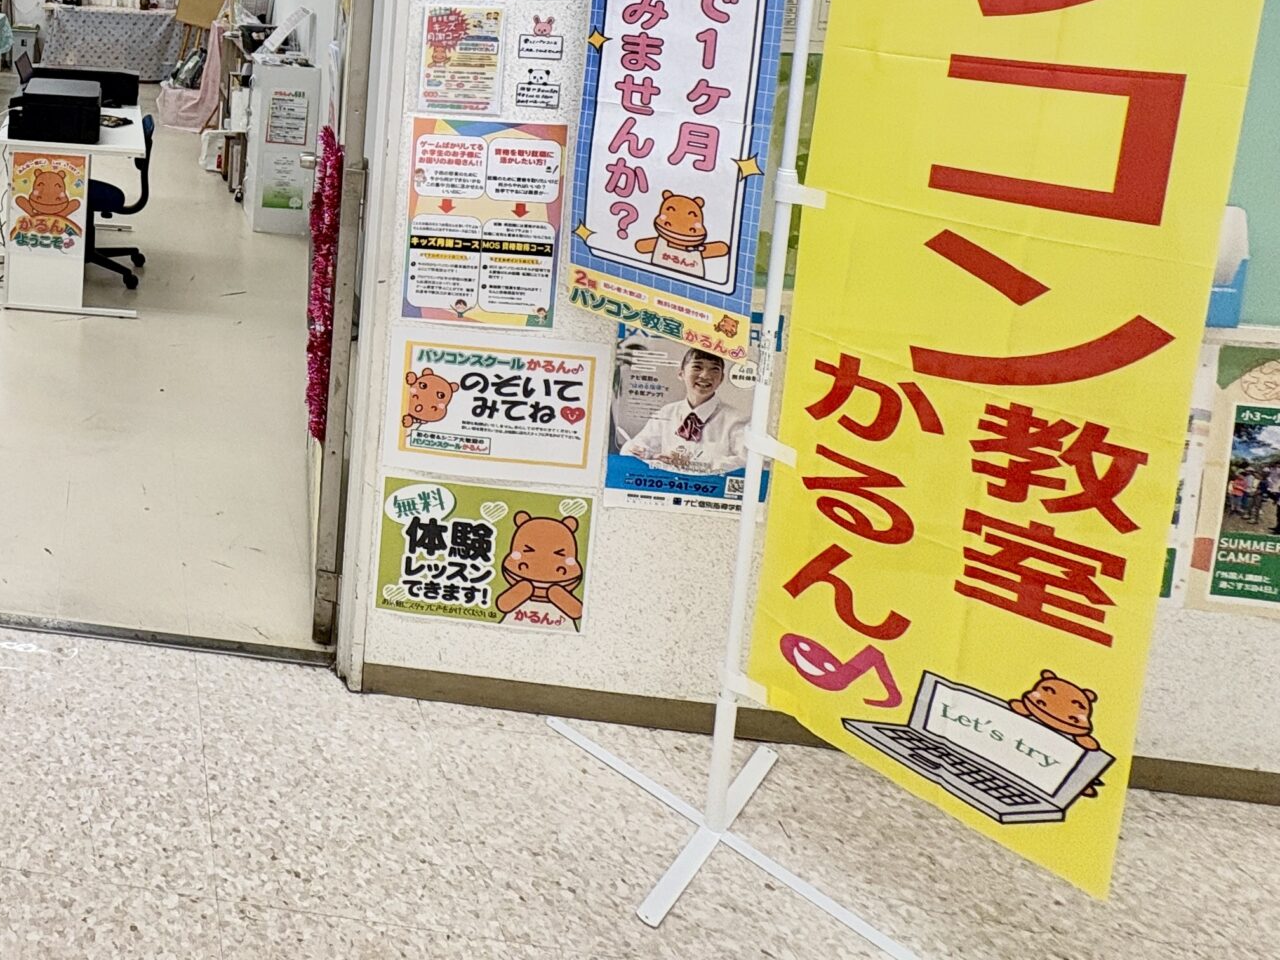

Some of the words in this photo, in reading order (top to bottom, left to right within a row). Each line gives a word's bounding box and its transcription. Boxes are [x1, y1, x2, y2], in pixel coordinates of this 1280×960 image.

[570, 287, 684, 339] パソコン教室
[461, 372, 584, 402] のぞいて
[471, 397, 556, 423] みてね
[635, 478, 718, 493] 0120-941-967
[782, 351, 945, 641] かるん
[394, 488, 444, 518] 無料
[405, 517, 493, 562] 体験
[404, 557, 491, 583] レッスン
[1218, 551, 1261, 564] CAMP
[1015, 738, 1060, 767] try
